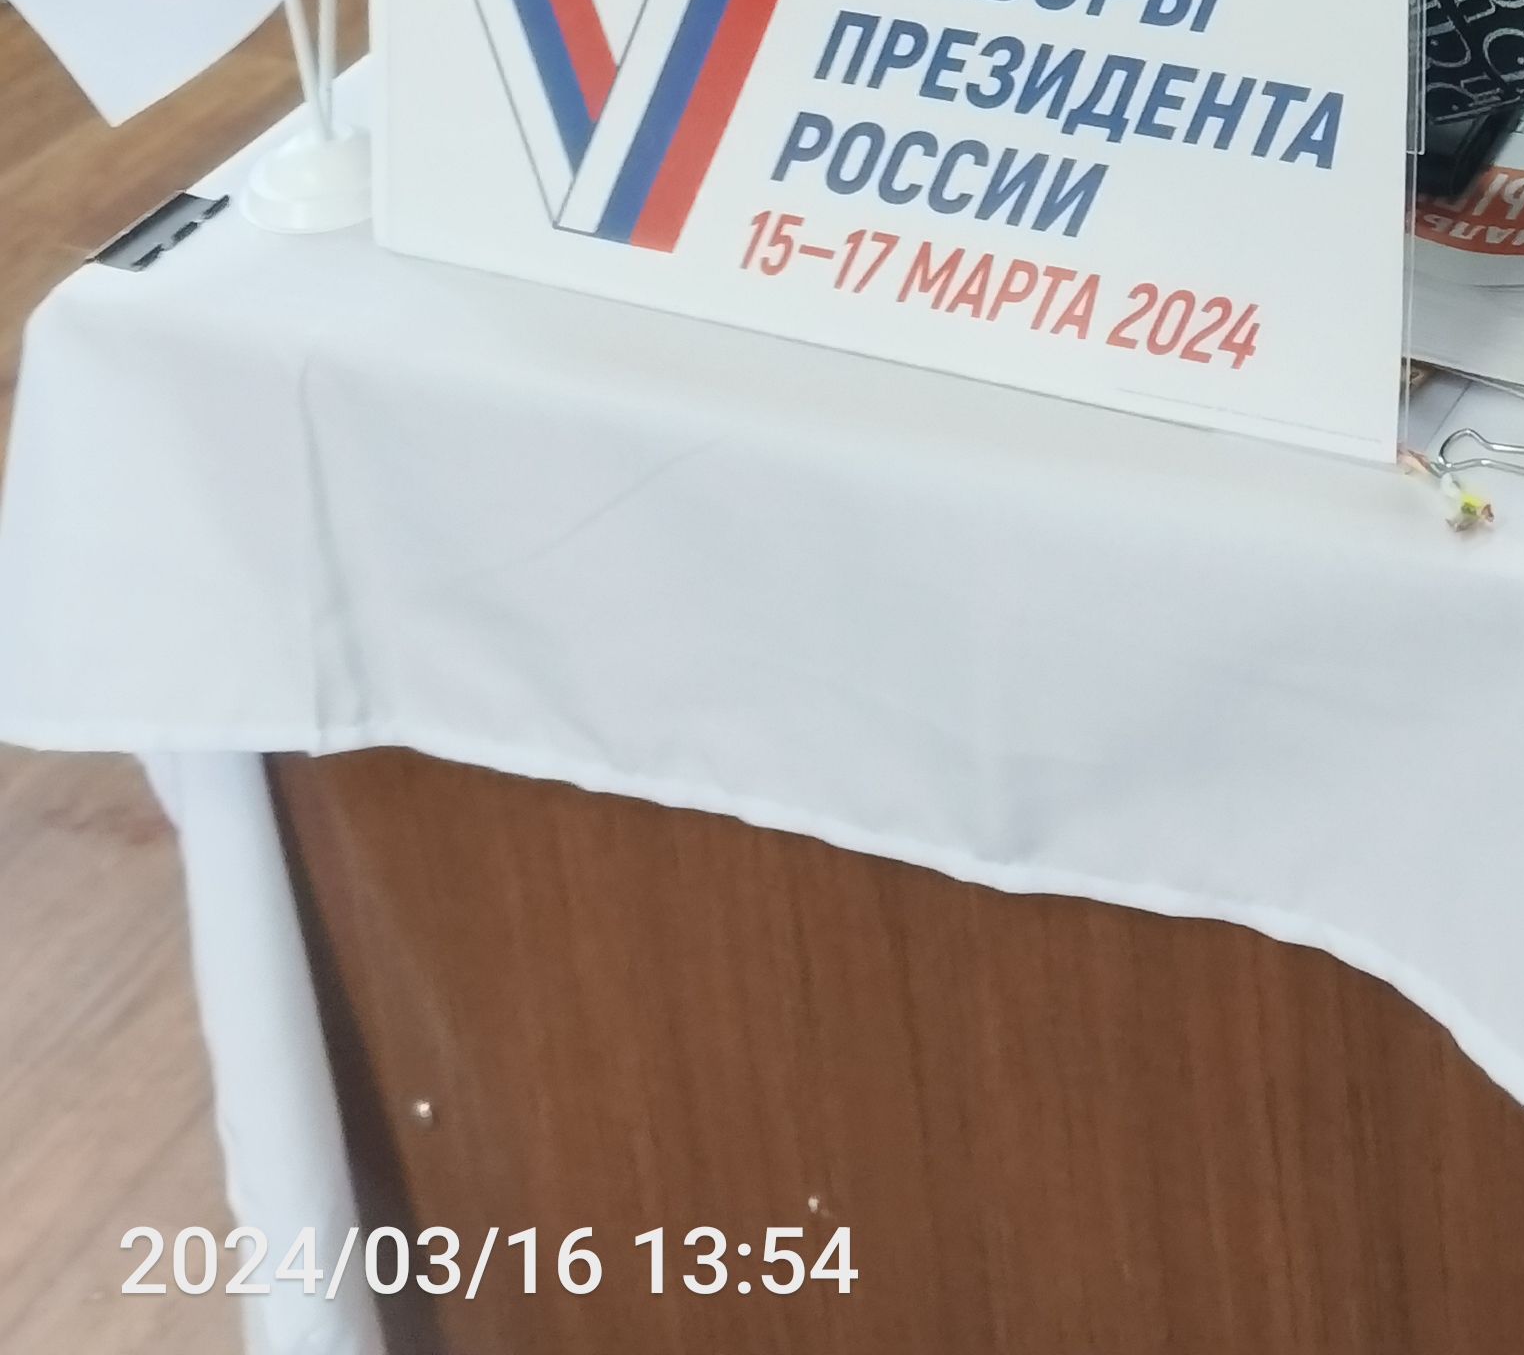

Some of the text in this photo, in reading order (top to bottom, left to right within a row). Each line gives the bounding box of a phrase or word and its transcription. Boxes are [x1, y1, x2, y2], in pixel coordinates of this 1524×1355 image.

[815, 9, 1345, 171] ПРЕЗИДЕНТА
[778, 111, 1107, 238] РОССИИ
[898, 240, 1101, 341] МАРТА
[1106, 281, 1259, 371] 2024
